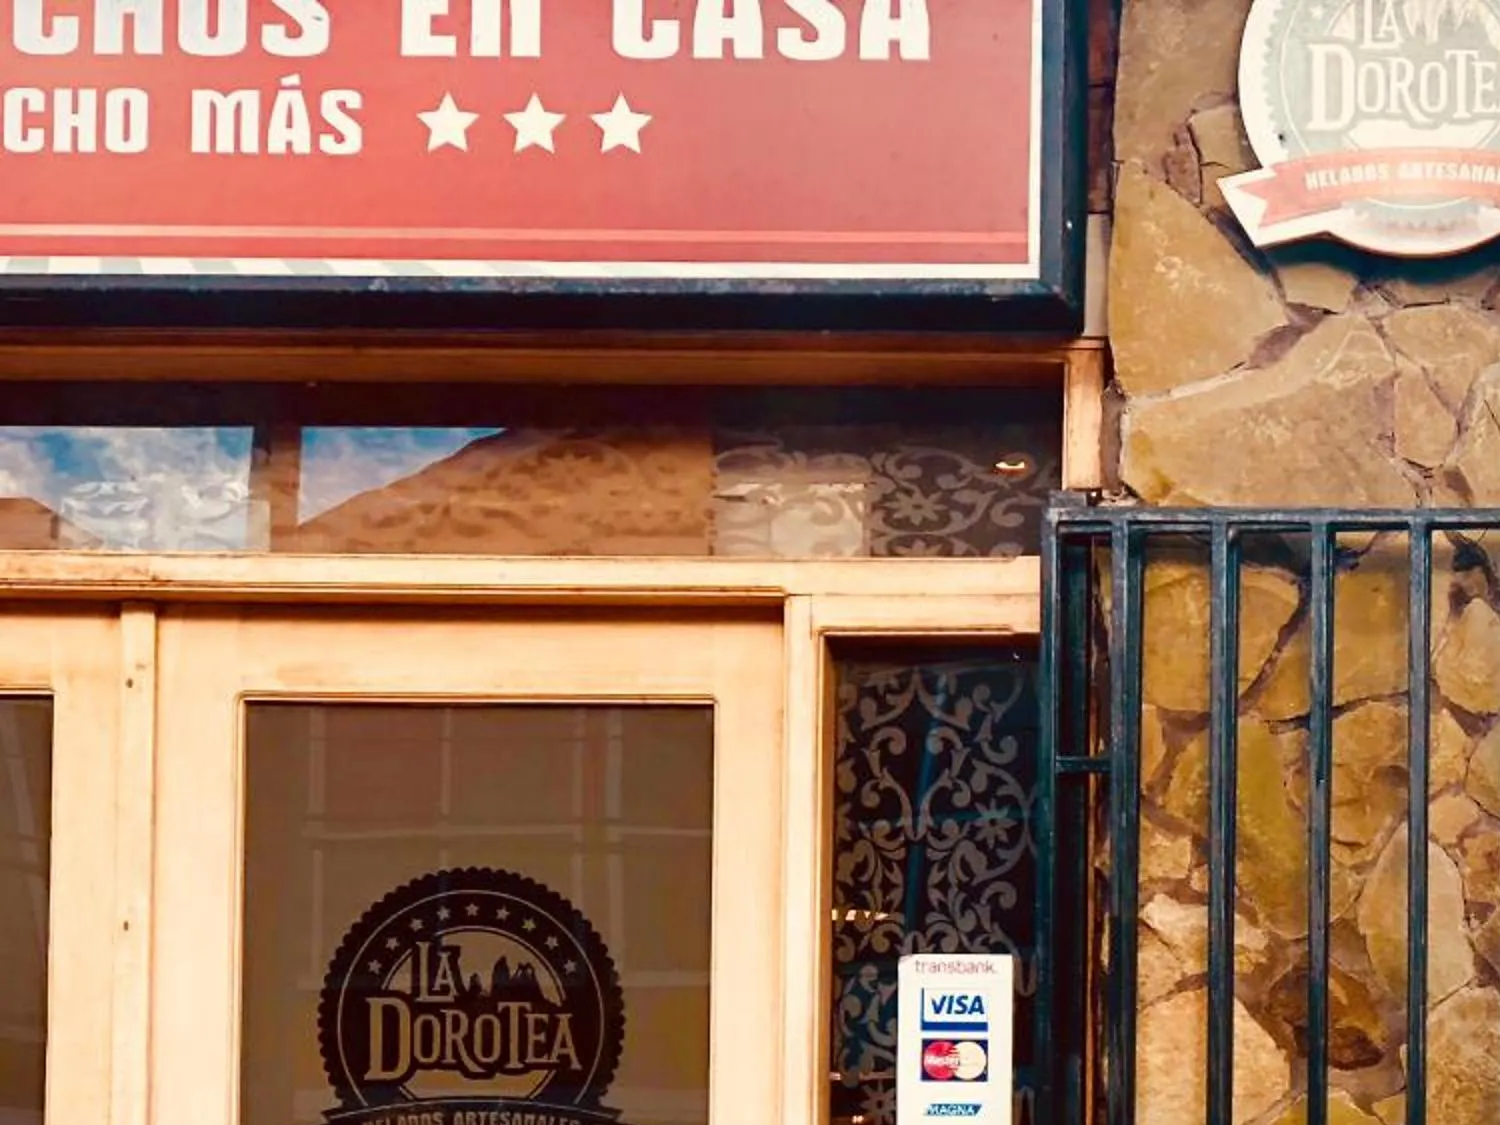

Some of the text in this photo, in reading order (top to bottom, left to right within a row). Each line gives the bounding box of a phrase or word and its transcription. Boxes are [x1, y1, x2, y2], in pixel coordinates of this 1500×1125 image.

[612, 0, 931, 61] CASA
[2, 73, 363, 155] CHO MÁS
[1304, 161, 1390, 191] HELADOS
[414, 941, 459, 1003] LA
[931, 995, 985, 1015] VISA
[363, 997, 583, 1081] DOROTEA
